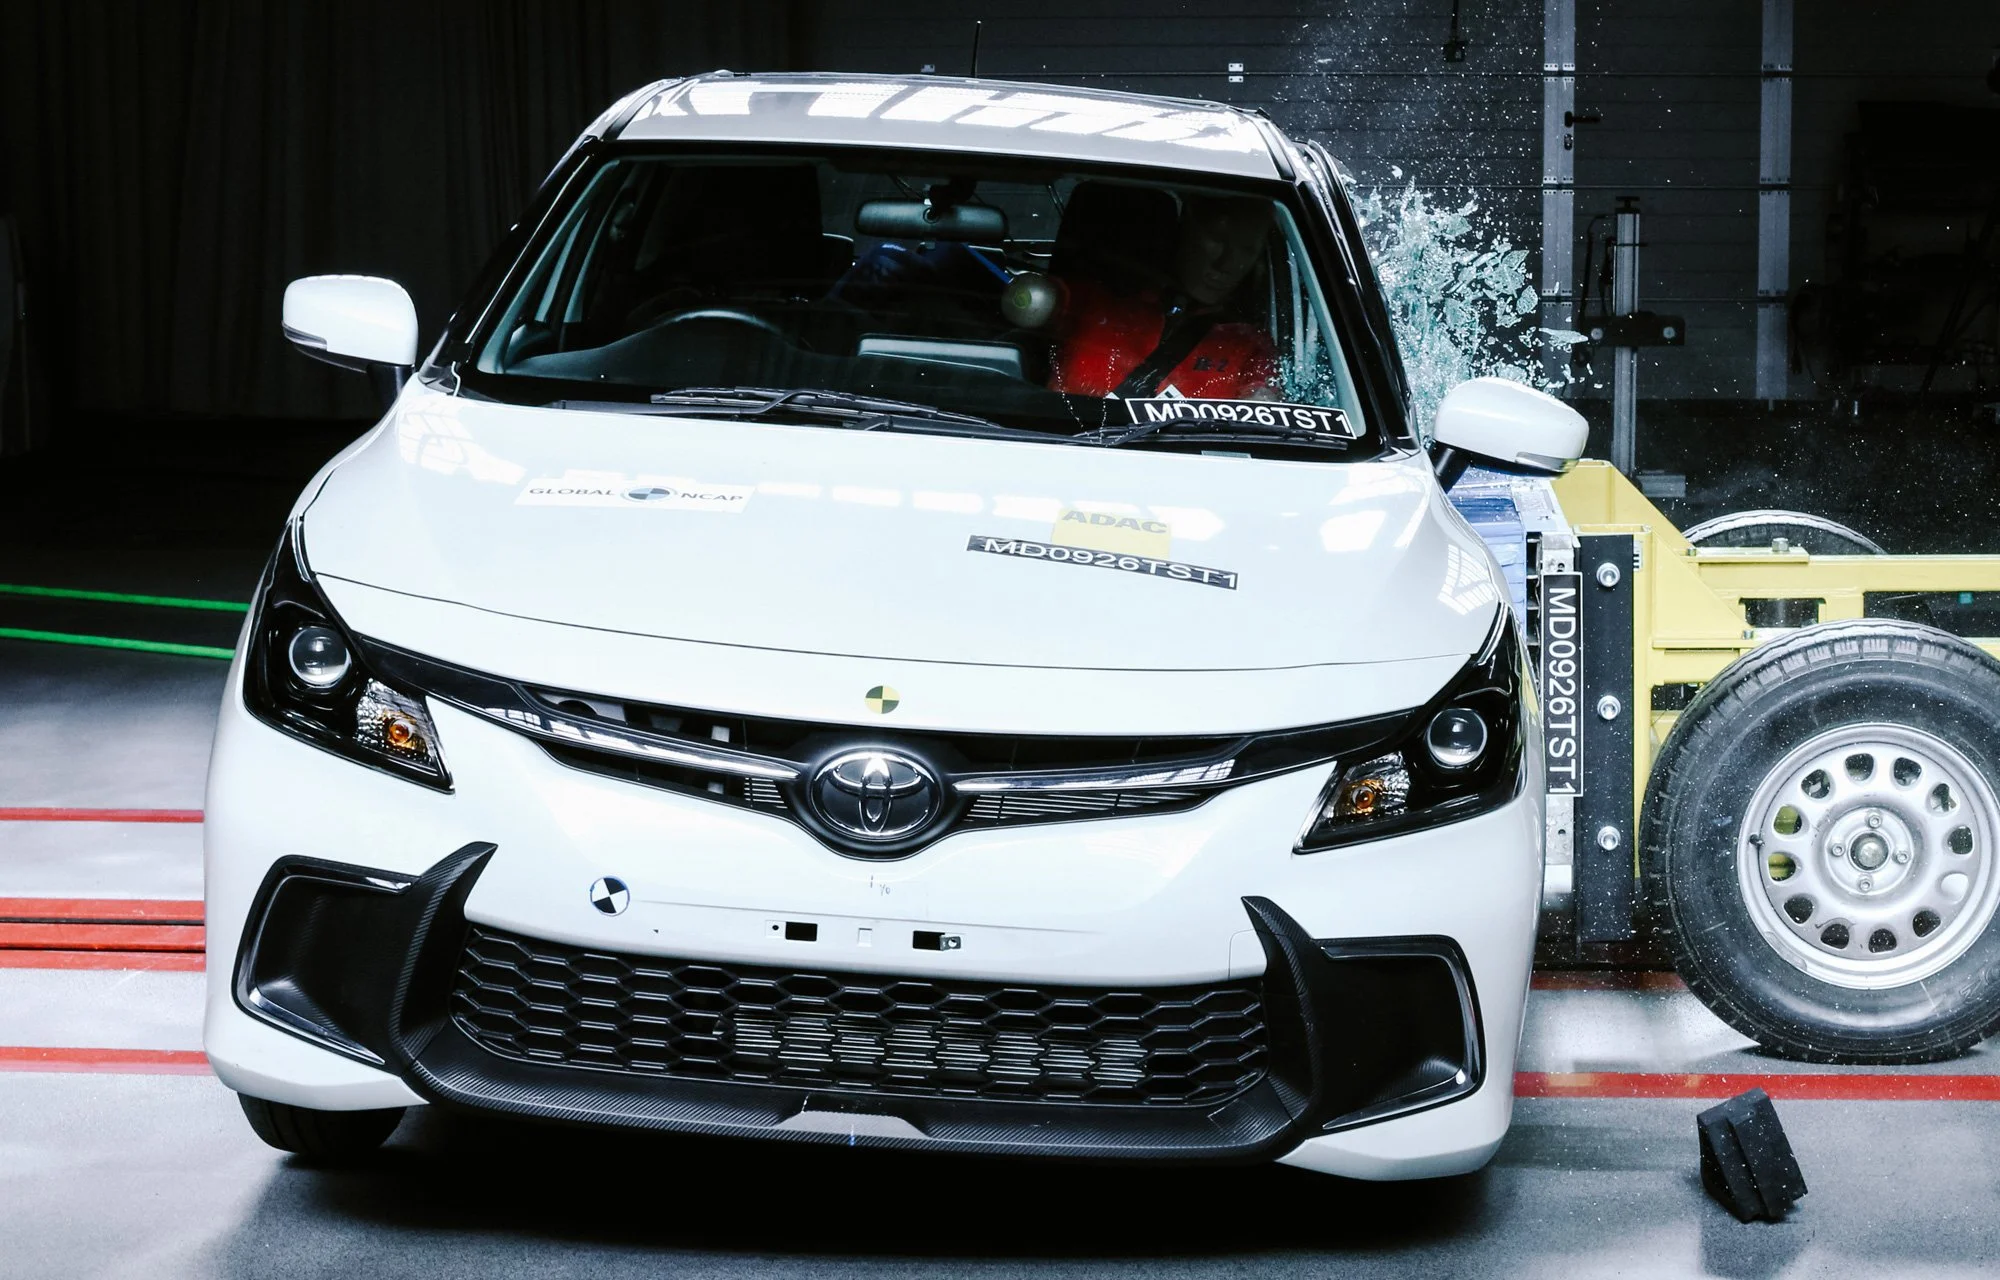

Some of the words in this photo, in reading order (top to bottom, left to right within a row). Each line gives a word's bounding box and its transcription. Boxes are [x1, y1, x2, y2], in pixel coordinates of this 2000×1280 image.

[1144, 402, 1351, 433] MD0926TST1
[529, 488, 615, 496] GLOBAL
[681, 492, 743, 501] NCAP
[1062, 510, 1167, 534] ADAC
[984, 538, 1237, 588] MD0926TST1
[1549, 587, 1576, 793] MD0926TST1
